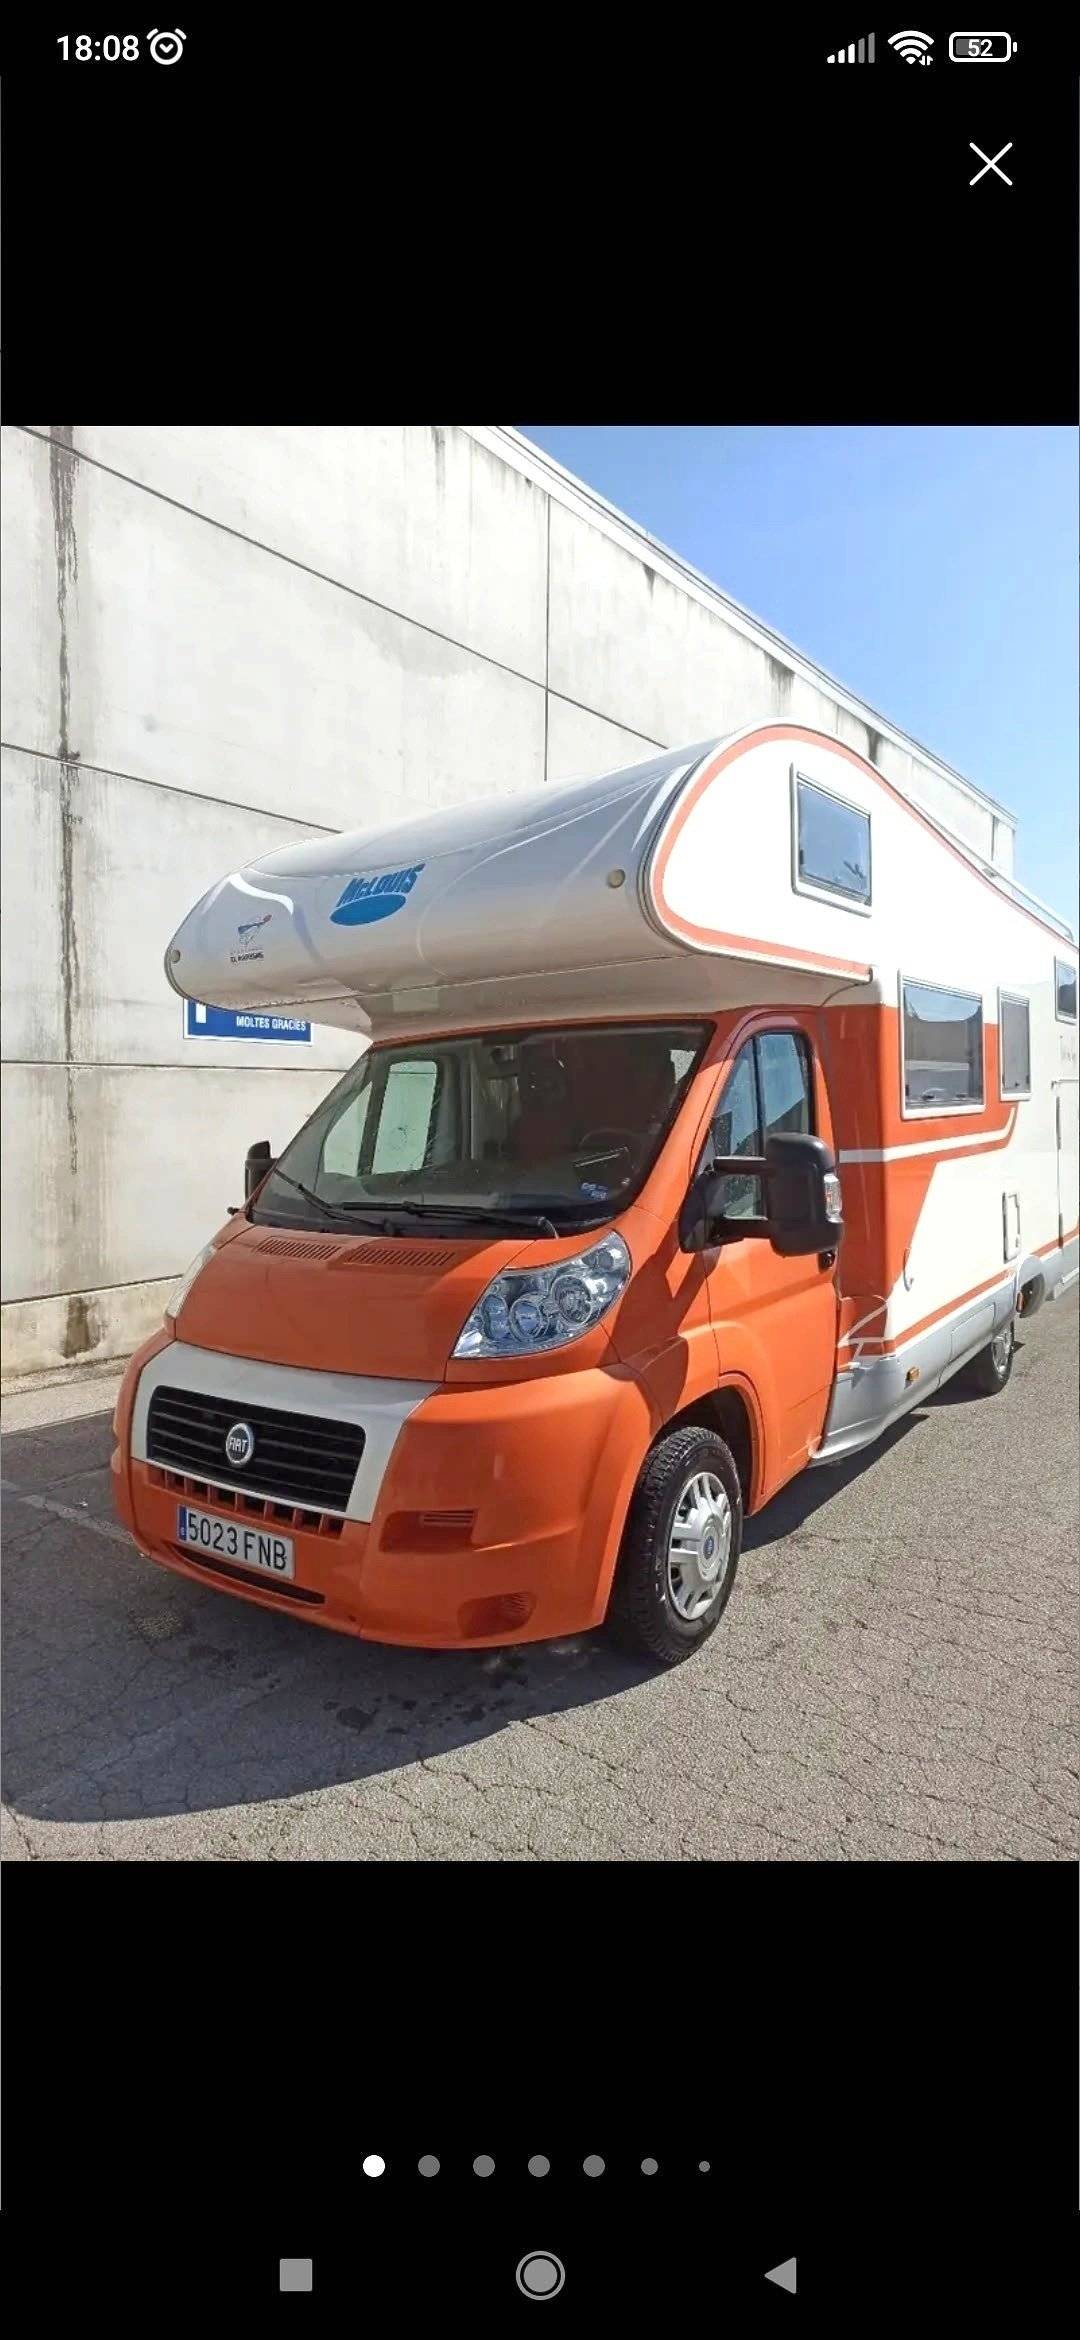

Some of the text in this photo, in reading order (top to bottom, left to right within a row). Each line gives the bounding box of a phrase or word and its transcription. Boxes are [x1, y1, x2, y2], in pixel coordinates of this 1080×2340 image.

[236, 1016, 269, 1029] MOLTES
[228, 1437, 249, 1453] FIAT
[188, 1513, 288, 1571] 5023 FNB
